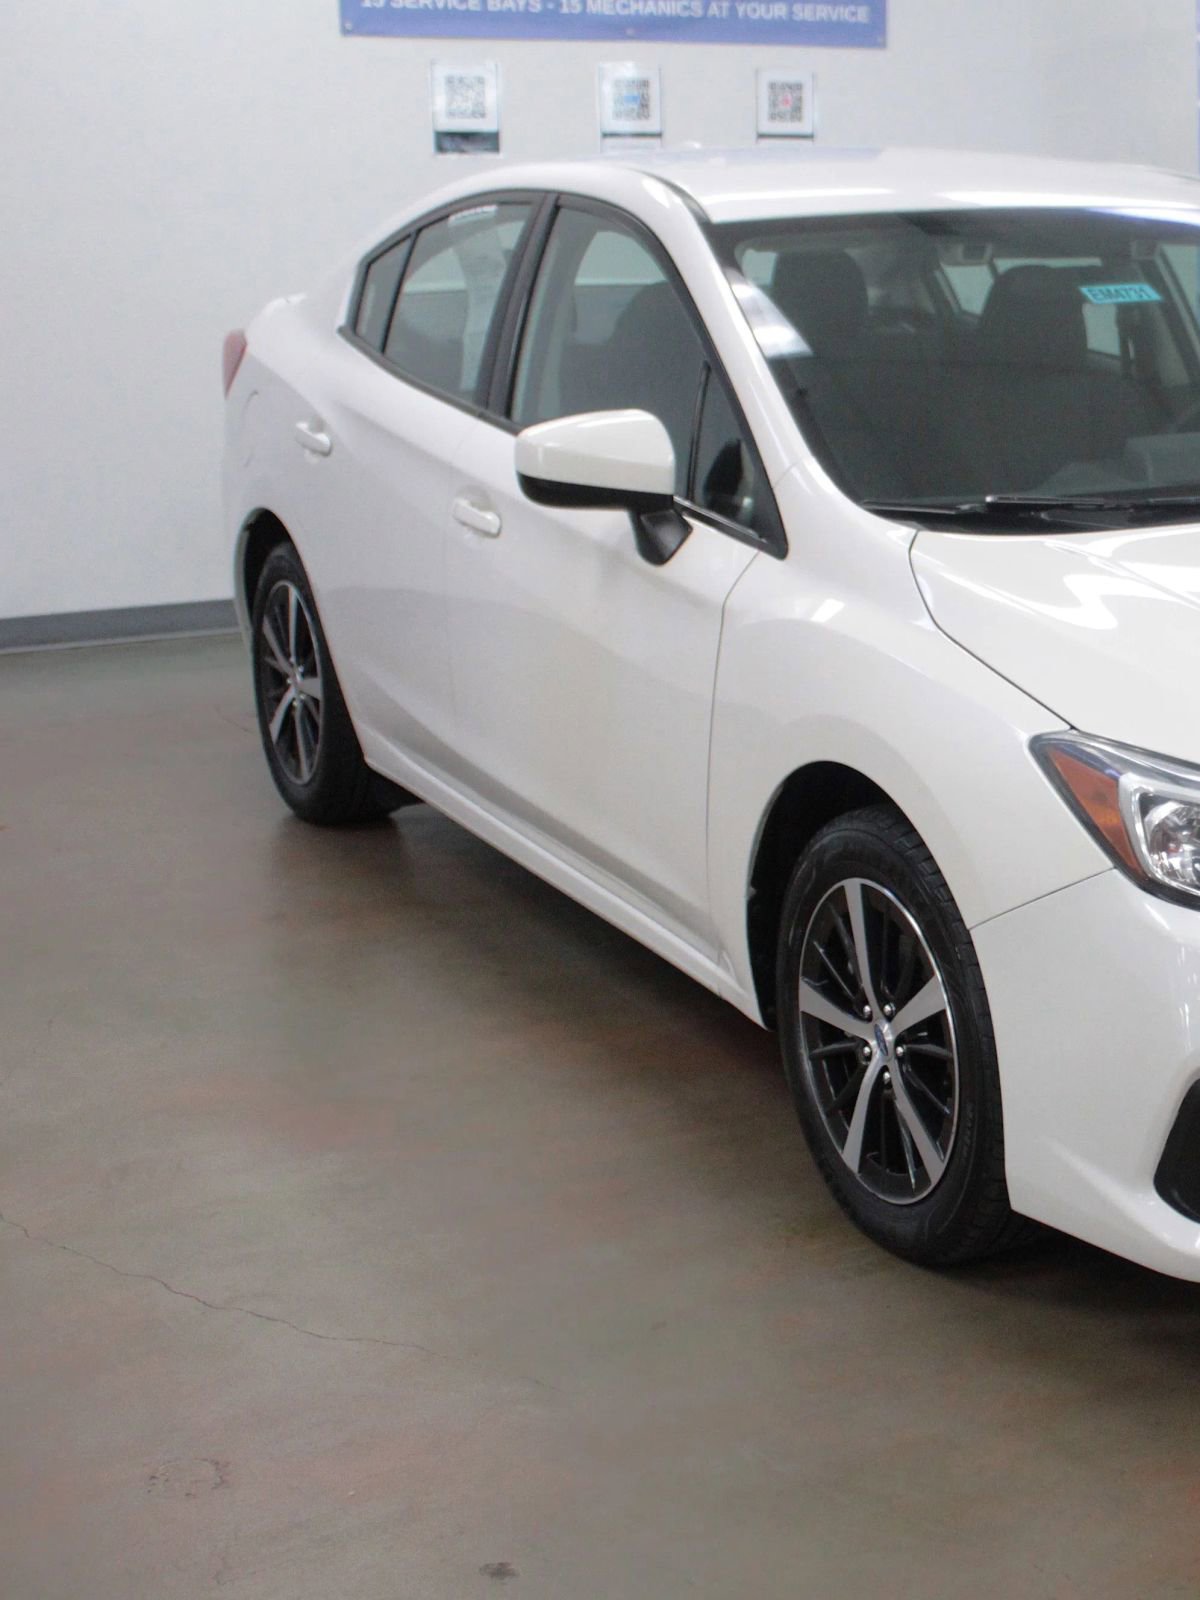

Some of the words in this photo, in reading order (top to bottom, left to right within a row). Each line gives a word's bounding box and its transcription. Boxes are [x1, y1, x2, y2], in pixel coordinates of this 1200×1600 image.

[487, 0, 541, 13] BAYS
[559, 0, 581, 14] 15
[586, 0, 701, 18] MECHANICS
[706, 4, 730, 19] AT
[735, 4, 787, 20] YOUR
[792, 5, 870, 24] SERVICE
